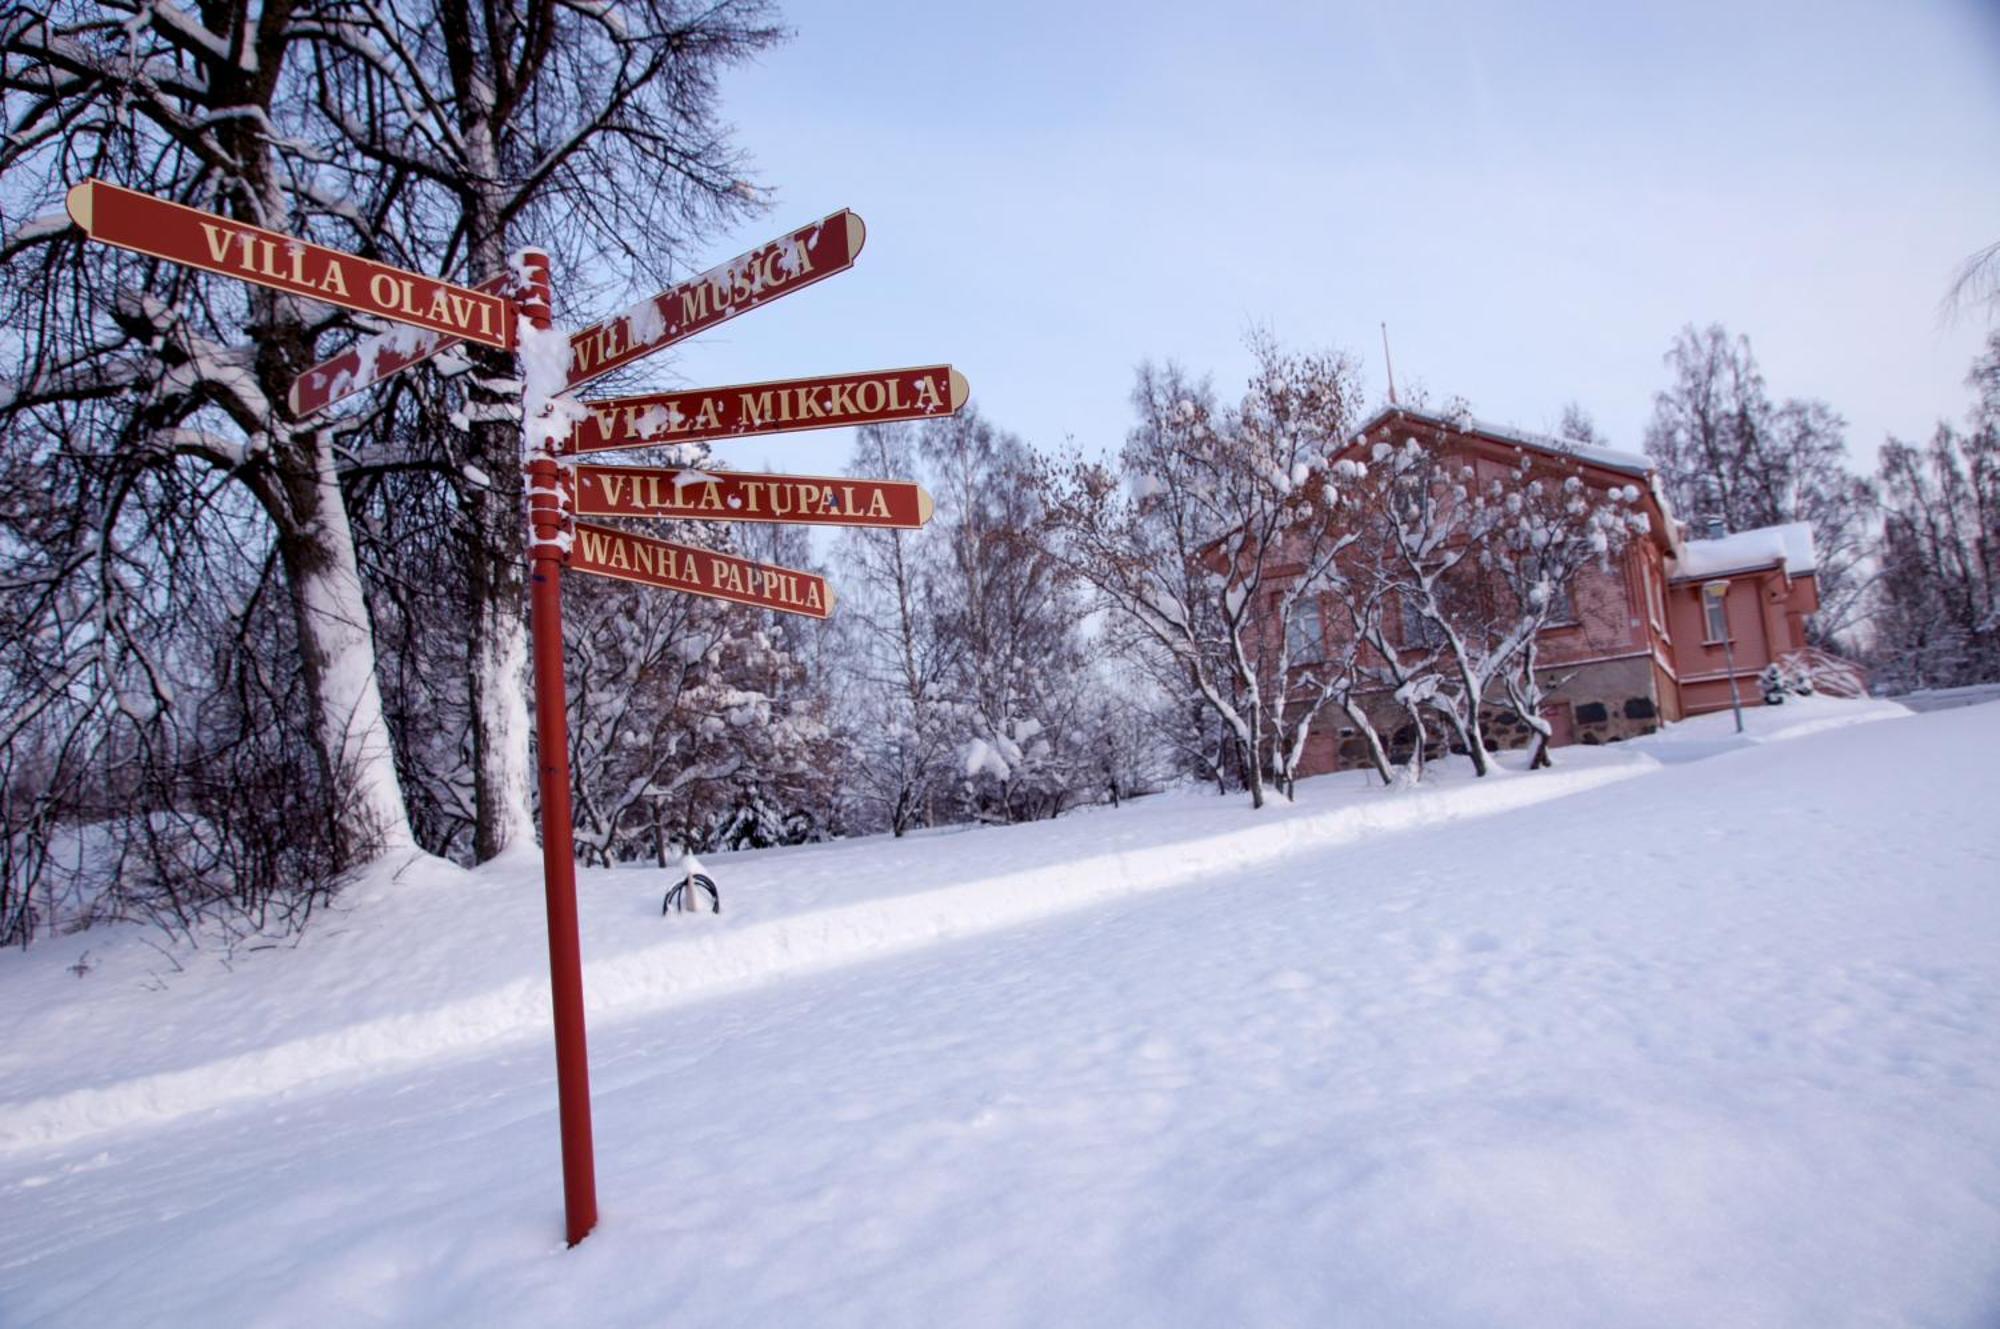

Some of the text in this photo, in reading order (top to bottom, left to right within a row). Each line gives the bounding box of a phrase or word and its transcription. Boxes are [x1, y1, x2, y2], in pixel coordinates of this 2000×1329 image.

[199, 222, 493, 335] VILLA OLAVI
[573, 304, 667, 373] VILL
[739, 375, 943, 424] MIKKOLA
[597, 474, 892, 519] VILLA TUPALA
[578, 530, 824, 610] WANHA PAPPILA
